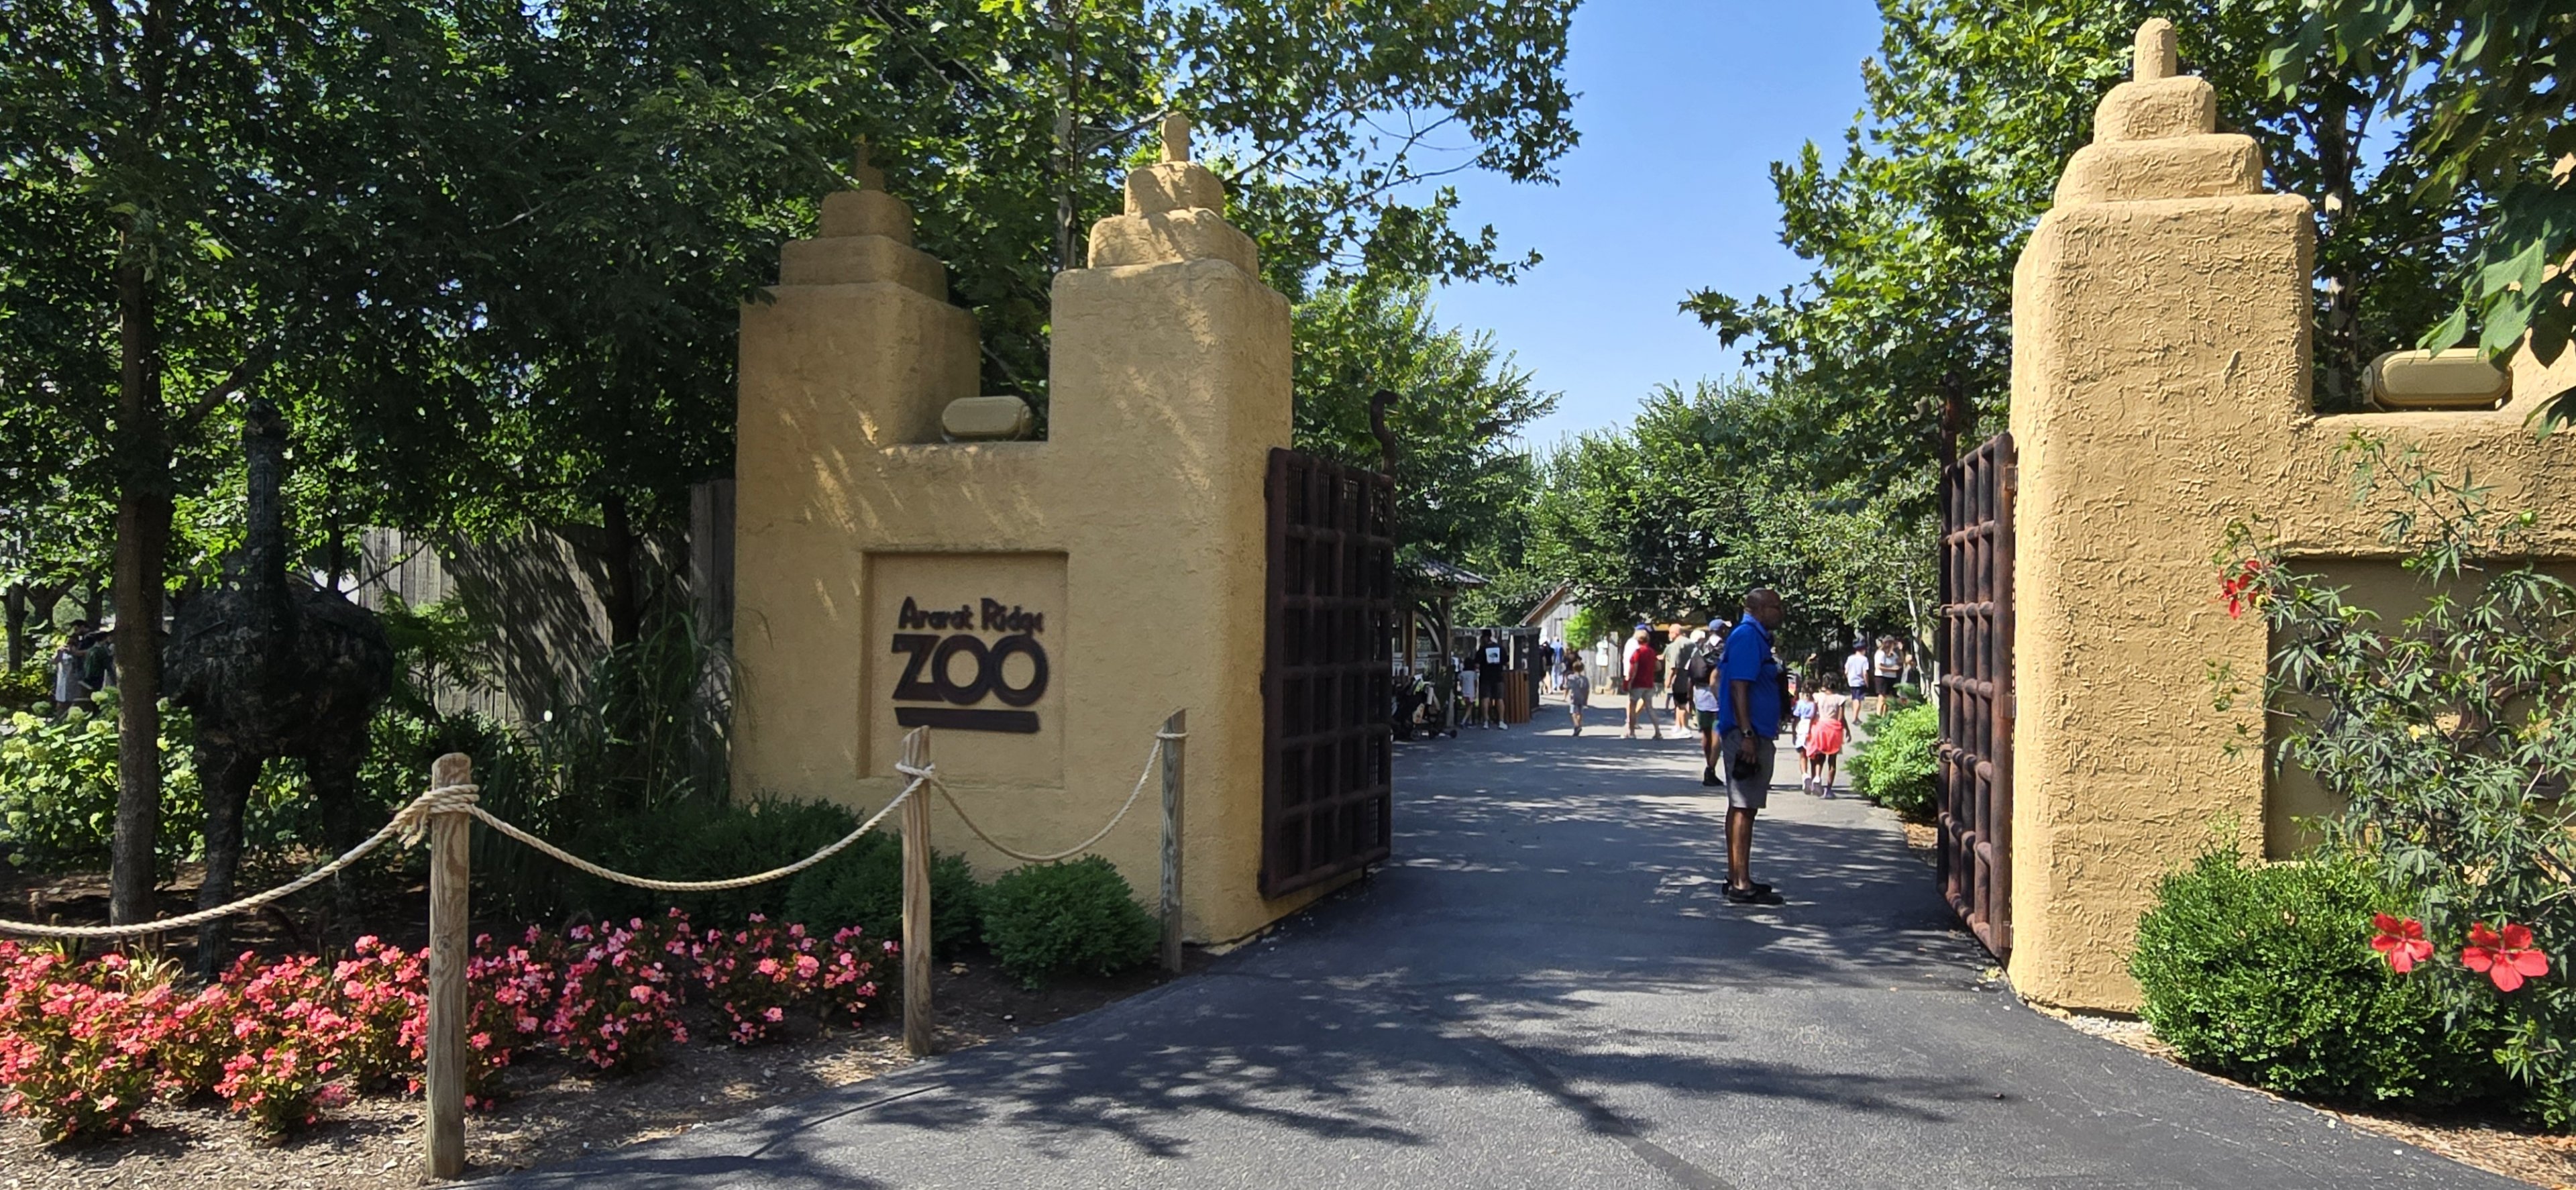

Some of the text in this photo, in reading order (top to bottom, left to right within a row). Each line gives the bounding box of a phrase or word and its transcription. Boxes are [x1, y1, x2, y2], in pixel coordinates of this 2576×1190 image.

[898, 596, 1044, 637] Ararat Ridge
[892, 633, 1049, 707] ZOO
